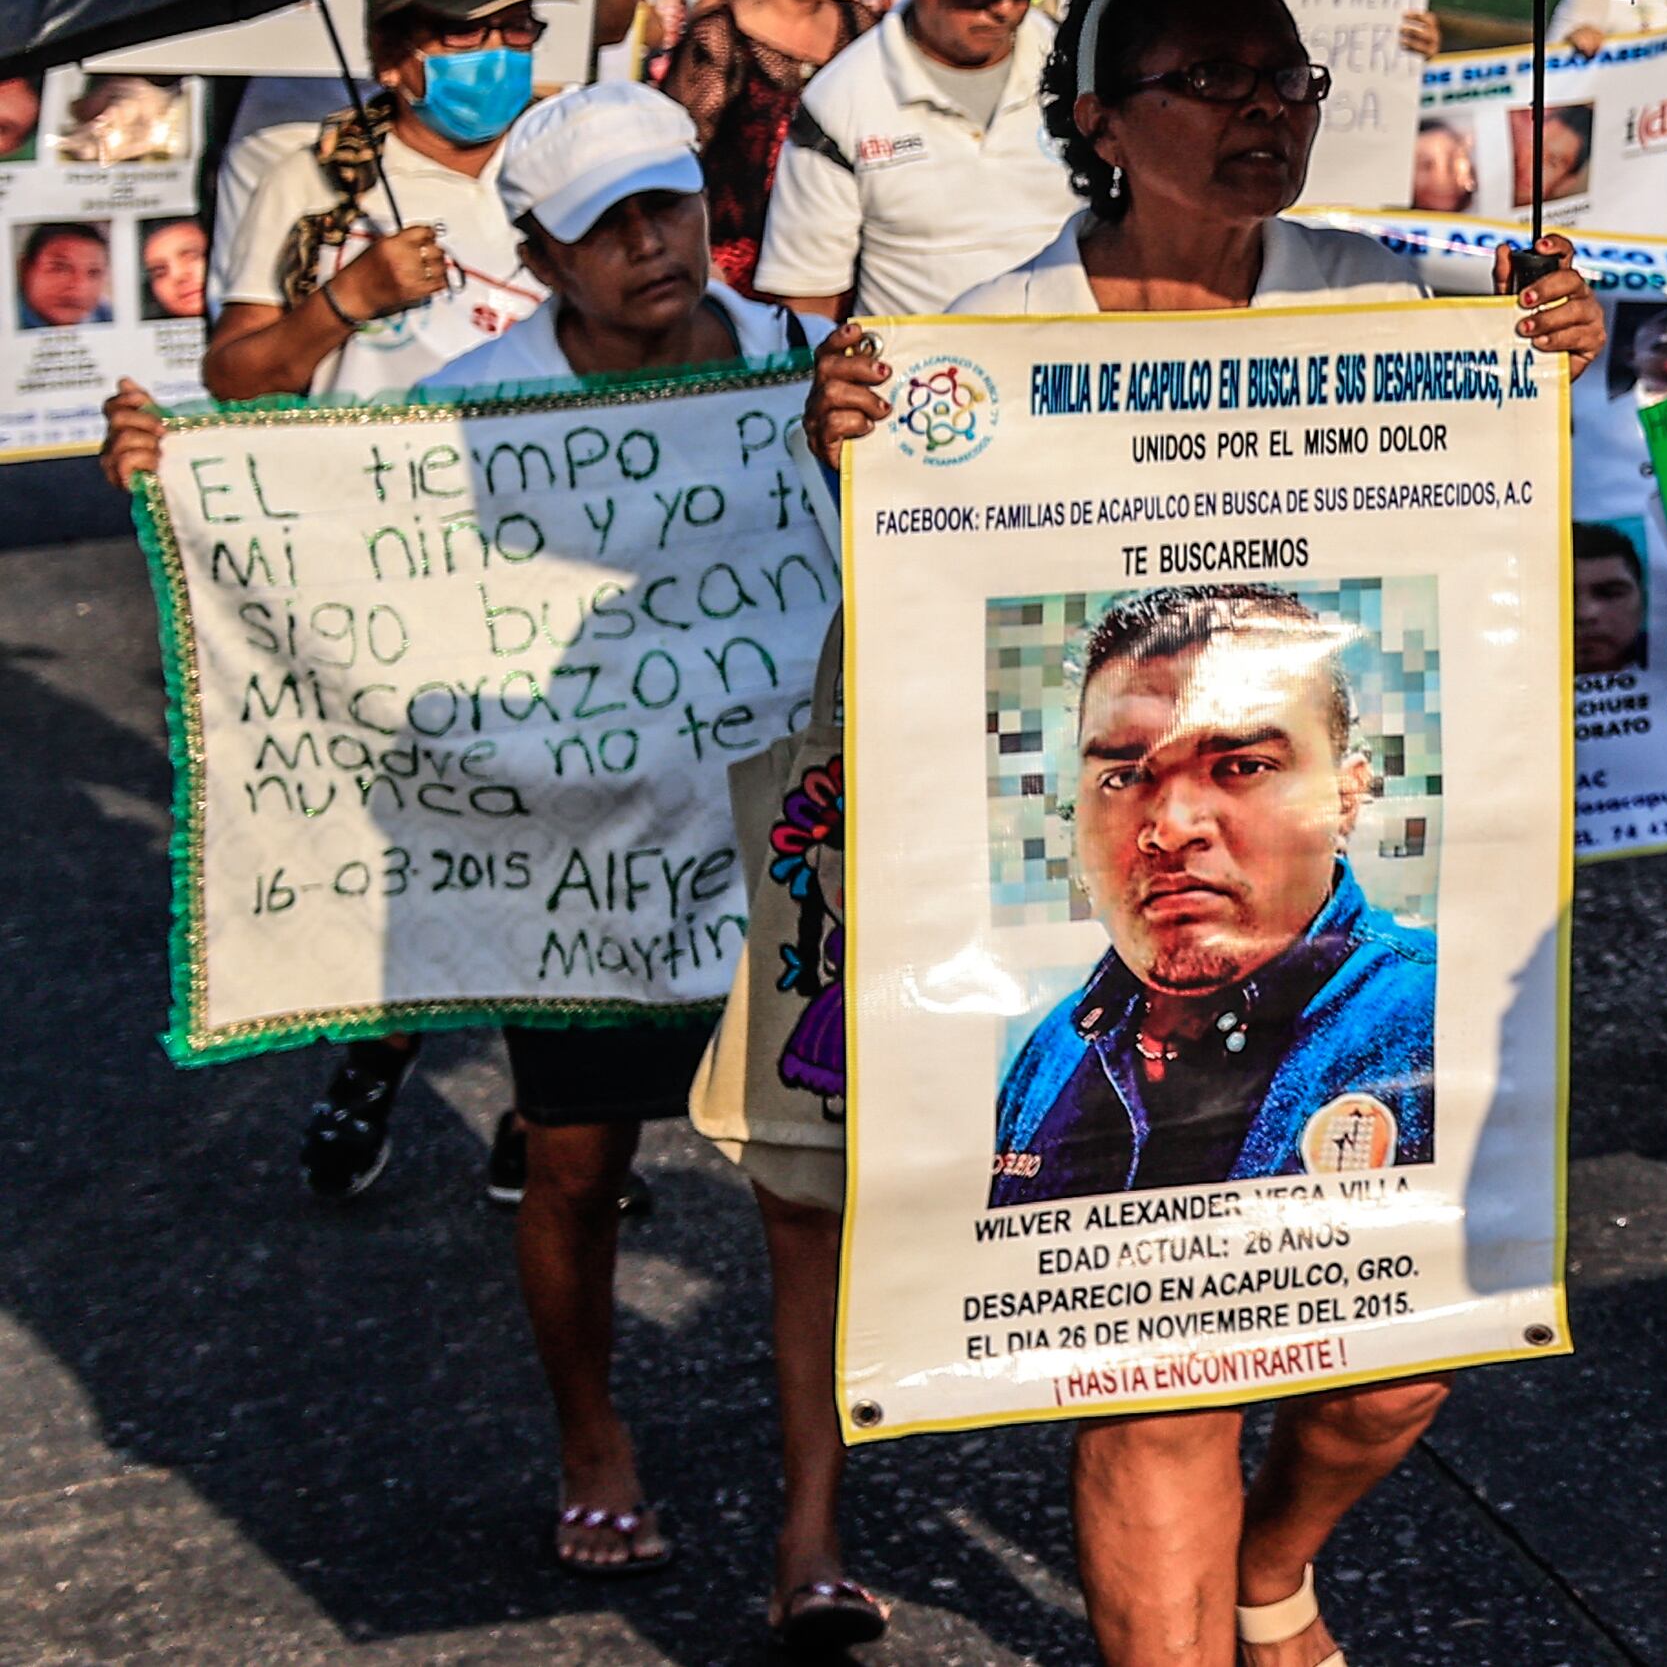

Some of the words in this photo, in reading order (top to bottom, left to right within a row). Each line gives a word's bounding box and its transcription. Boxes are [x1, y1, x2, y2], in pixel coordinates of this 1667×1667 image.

[1098, 363, 1121, 412] DE
[1126, 360, 1212, 412] ACAPULCO
[1218, 359, 1241, 409] EN
[1248, 357, 1300, 408] BUSCA
[1307, 355, 1329, 406] DE
[1336, 353, 1366, 404] SUS
[1132, 433, 1206, 463] UNIDOS
[1218, 432, 1258, 459] POR
[1270, 430, 1293, 456] EL
[1304, 427, 1368, 456] MISMO
[1380, 424, 1448, 453] DOLOR
[367, 508, 545, 580] niño
[584, 496, 616, 555] y
[654, 482, 727, 549] yo
[876, 506, 980, 536] FACEBOOK:
[985, 501, 1065, 531] FAMILIAS
[1070, 500, 1093, 525] DE
[1097, 494, 1189, 524] ACAPULCO
[1195, 493, 1217, 517] EN
[1223, 490, 1282, 515] BUSCA
[1287, 489, 1308, 513] DE
[1314, 487, 1348, 512] SUS
[1353, 481, 1500, 510] DESAPARECIDOS,
[1122, 546, 1148, 576] TE
[1160, 538, 1309, 574] BUSCAREMOS
[548, 728, 637, 777] no
[974, 1208, 1071, 1243] WILVER
[1084, 1191, 1243, 1232] ALEXANDER
[1038, 1244, 1110, 1276] EDAD
[963, 1279, 1152, 1322] DESAPARECIO
[1162, 1274, 1193, 1302] EN
[1200, 1262, 1349, 1299] ACAPULCO,
[1358, 1255, 1419, 1282] GRO.
[967, 1333, 997, 1361] EL
[1095, 1322, 1128, 1346] DE
[1138, 1300, 1289, 1342] NOVIEMBRE
[1298, 1297, 1346, 1325] DEL
[1353, 1291, 1415, 1319] 2015.
